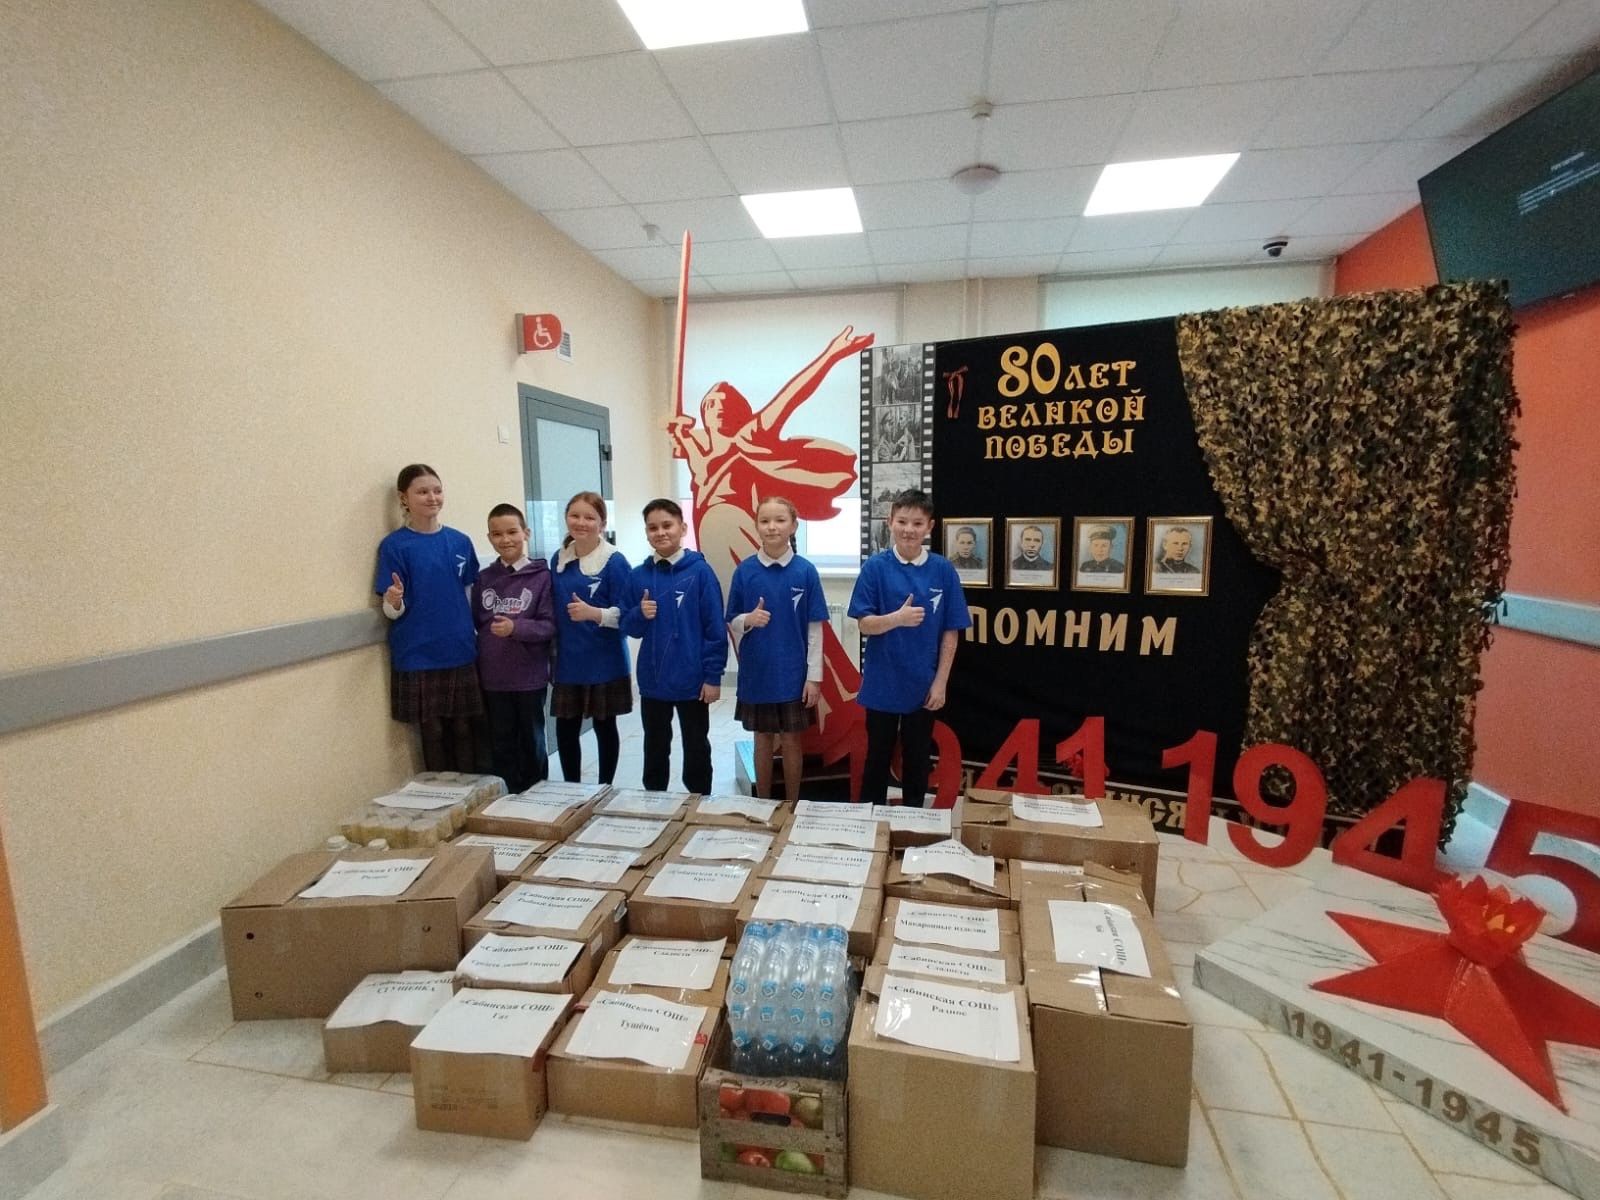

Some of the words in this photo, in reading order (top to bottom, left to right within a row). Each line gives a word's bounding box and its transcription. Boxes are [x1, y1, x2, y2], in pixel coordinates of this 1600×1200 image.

[997, 342, 1061, 397] 80
[1064, 360, 1137, 390] ЛЕТ
[977, 388, 1146, 430] ВЕЛИКОЙ
[983, 428, 1135, 460] ПОБЕДЫ
[965, 605, 1178, 656] ПОМНИМ
[1289, 1010, 1541, 1166] 1941-1945
